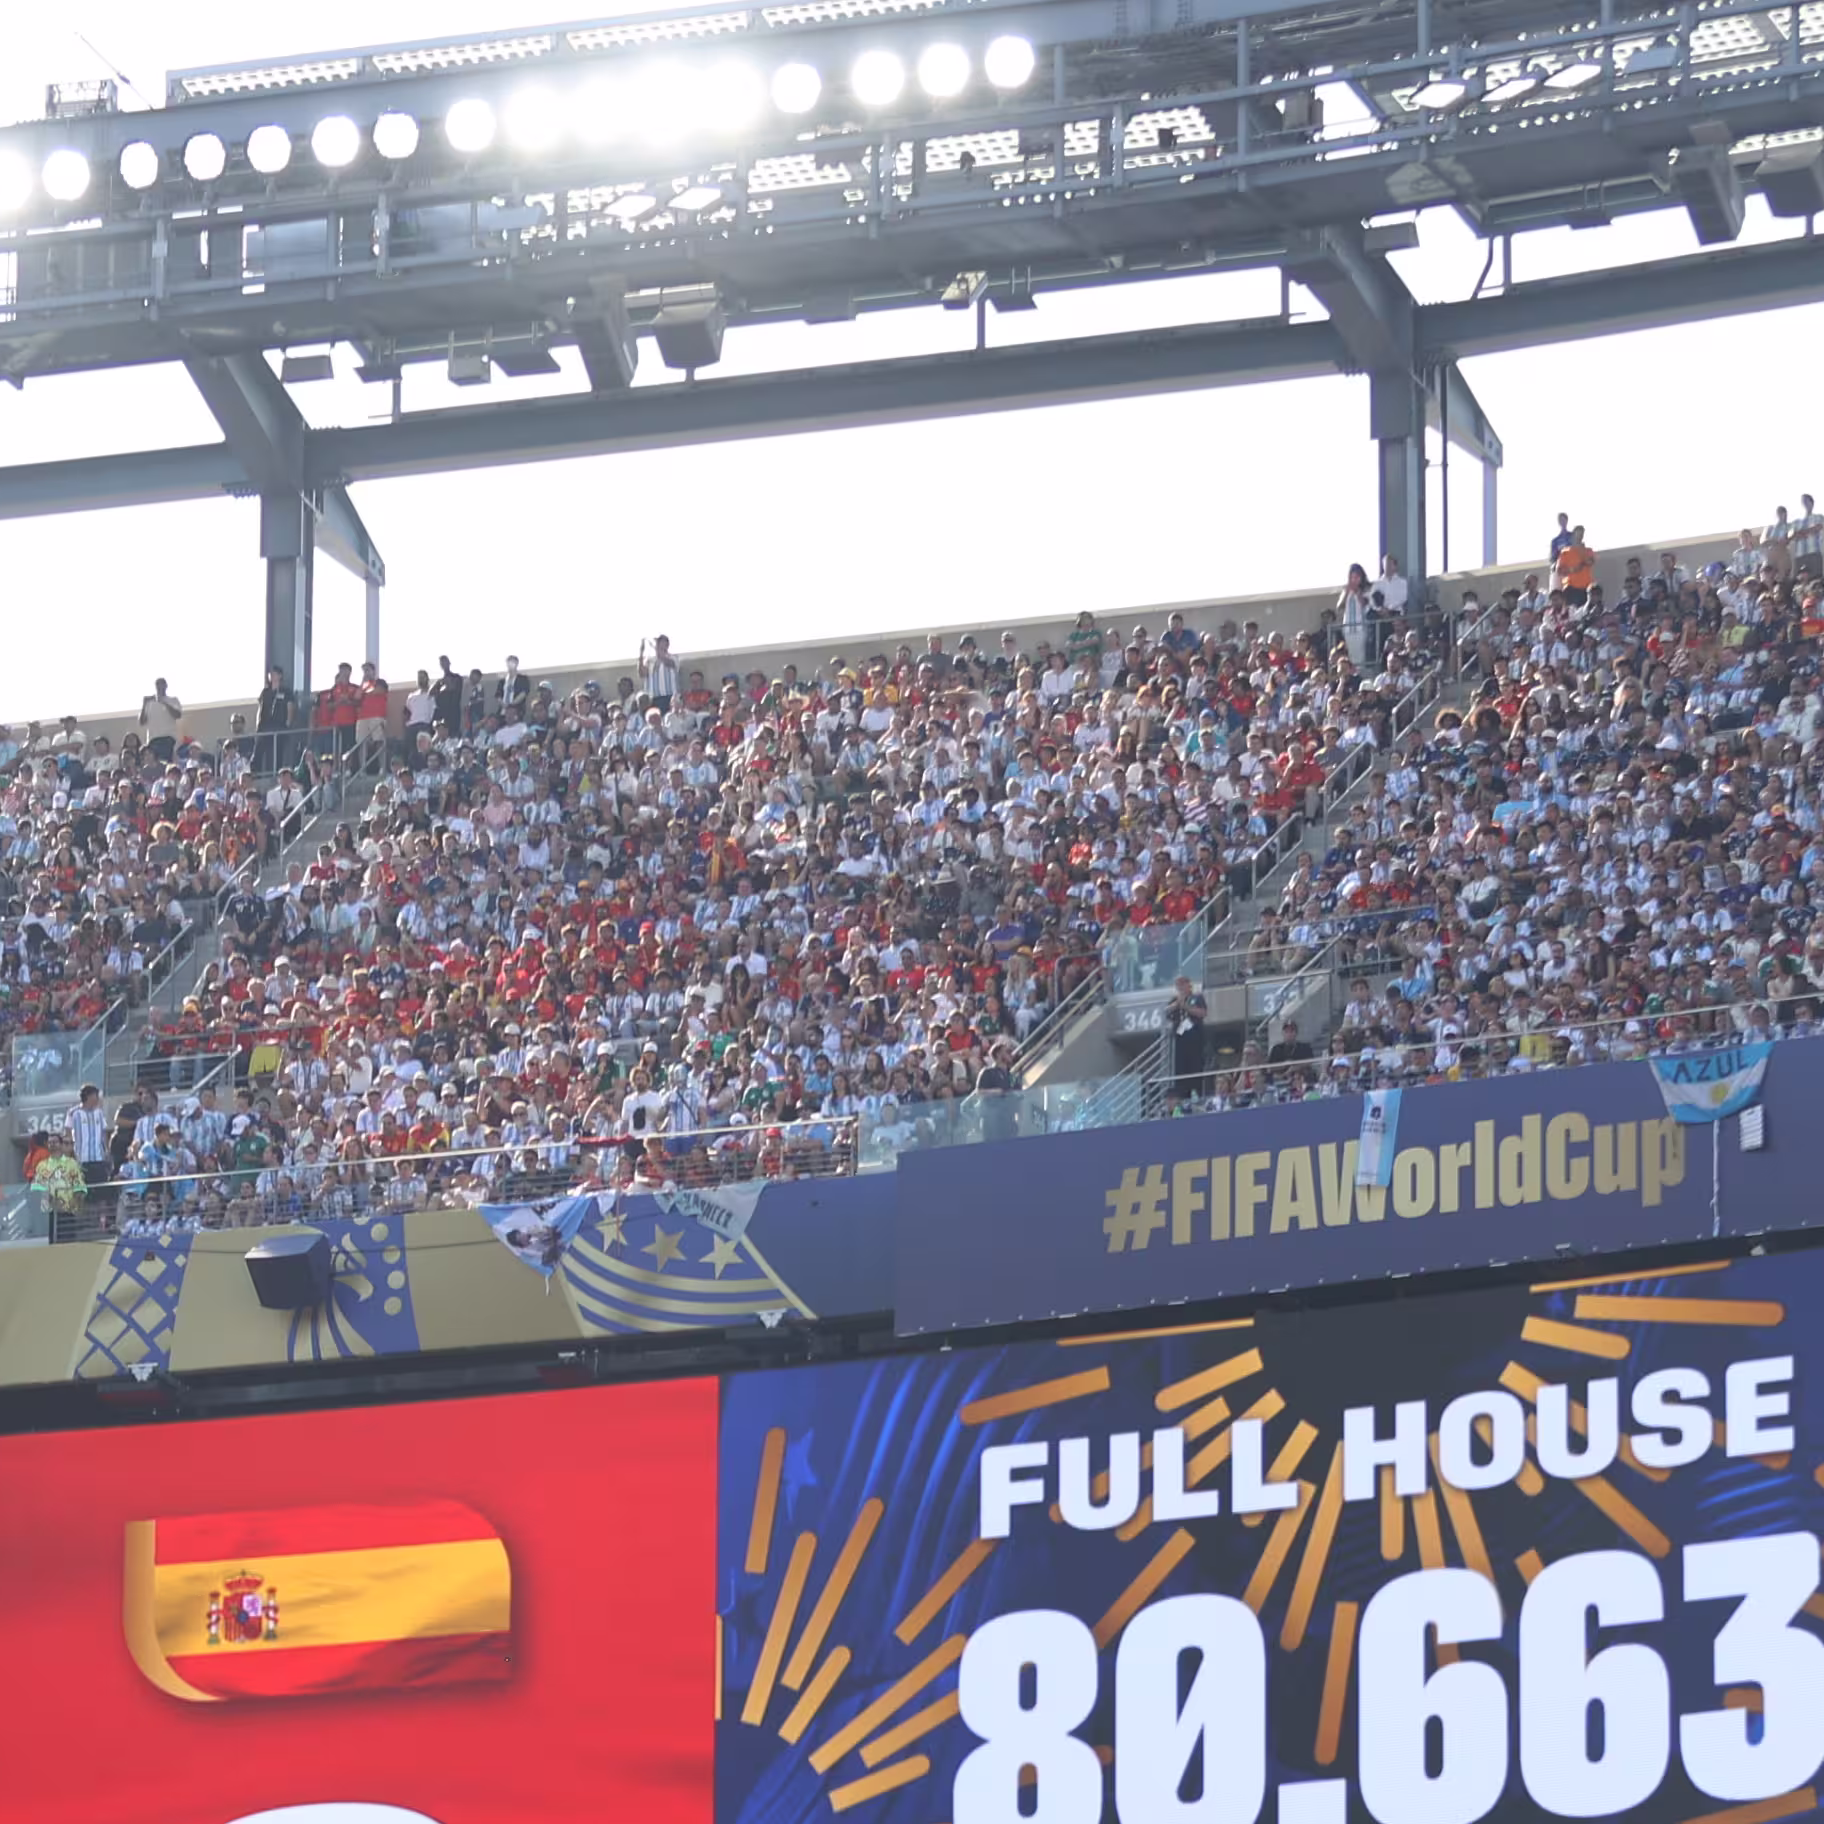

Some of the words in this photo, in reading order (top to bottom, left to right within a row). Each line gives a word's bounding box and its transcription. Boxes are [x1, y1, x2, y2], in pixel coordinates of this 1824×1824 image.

[1124, 1008, 1162, 1031] 346
[27, 1112, 65, 1135] 345
[1102, 1112, 1686, 1253] #FIFAWorldCup
[980, 1418, 1298, 1539] FULL
[1343, 1356, 1795, 1502] HOUSE
